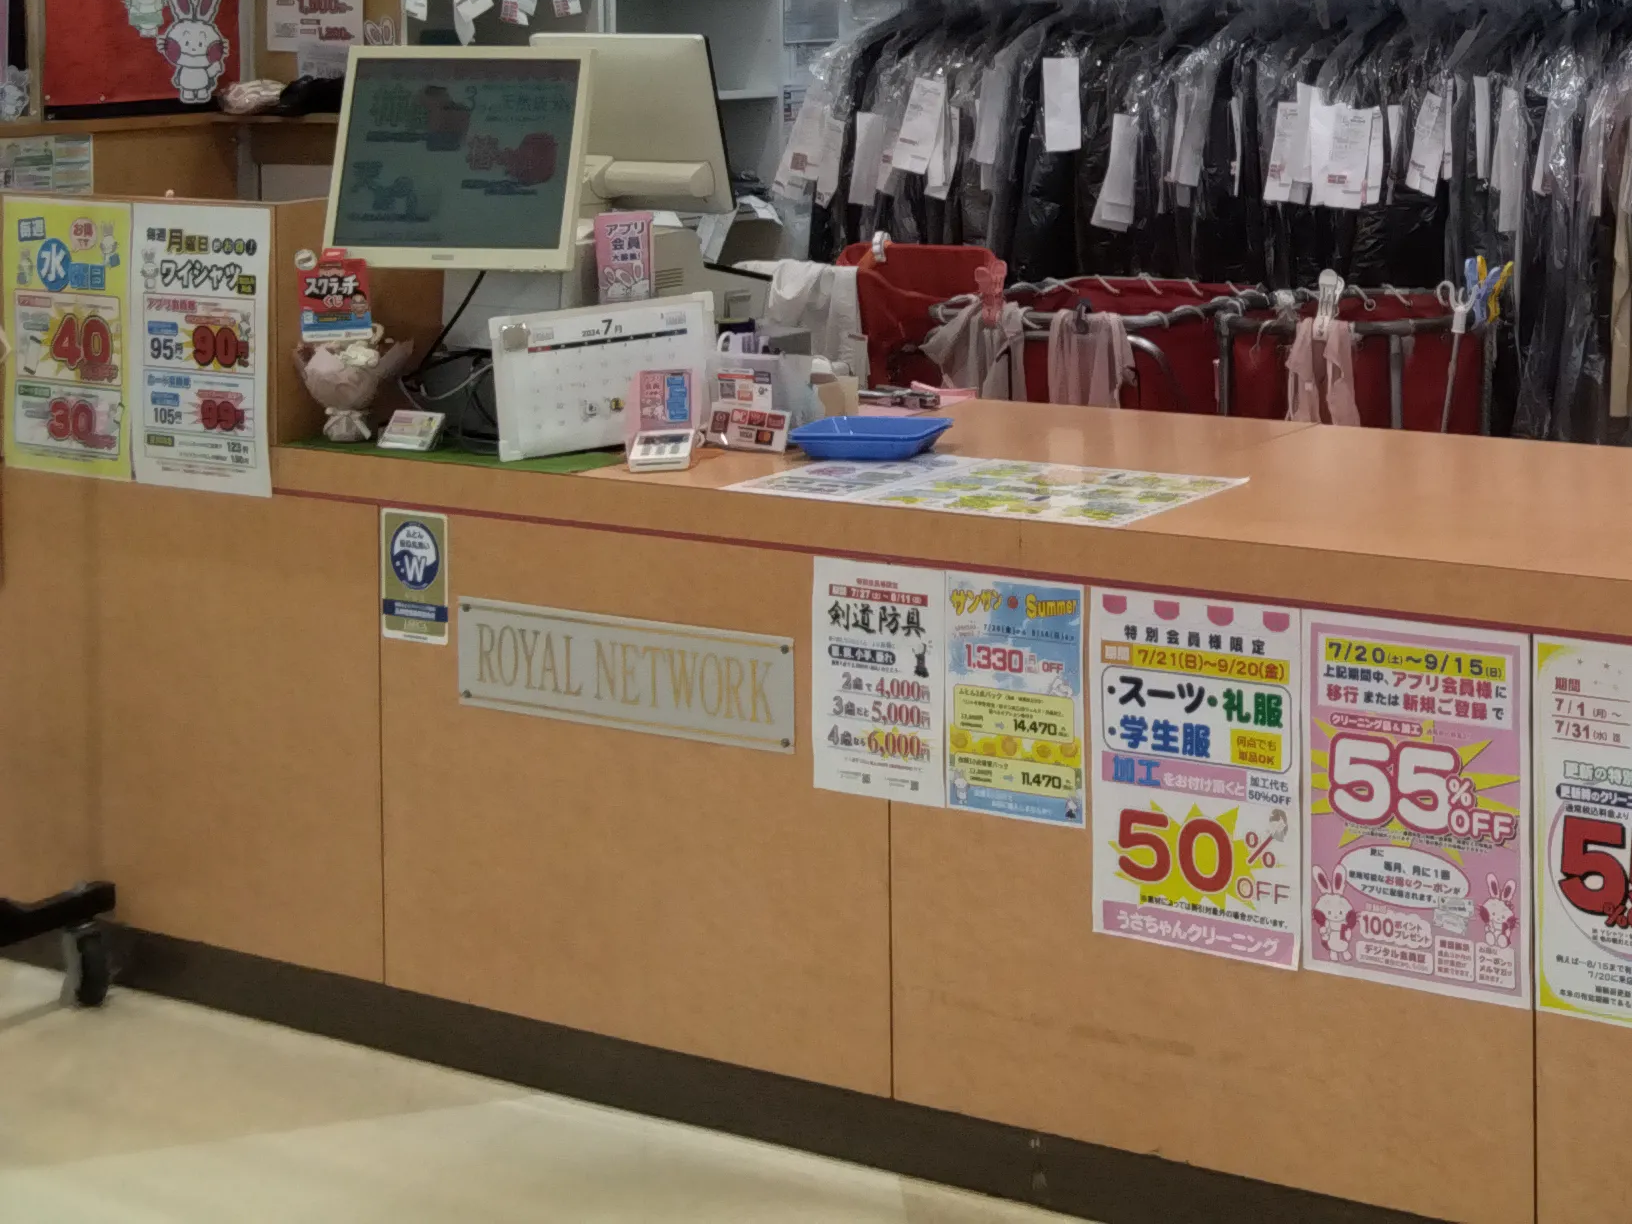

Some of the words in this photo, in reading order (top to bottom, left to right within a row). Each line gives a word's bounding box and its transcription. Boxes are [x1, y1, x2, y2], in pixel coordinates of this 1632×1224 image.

[606, 222, 645, 237] アプリ
[611, 236, 641, 251] 会員
[41, 243, 65, 283] 水
[160, 259, 242, 291] ワイシャツ
[304, 274, 359, 296] スクラッチ
[323, 295, 343, 308] くじ
[1025, 593, 1076, 619] Summer
[828, 599, 926, 637] 剣道防具
[1124, 625, 1266, 655] 特別会員様限定
[476, 622, 584, 697] ROYAL
[593, 637, 775, 725] NETWORK
[1042, 662, 1065, 674] OFF
[1555, 676, 1580, 692] 期間
[1013, 719, 1057, 736] 14,470
[1237, 735, 1277, 752] 何点でも
[1249, 776, 1289, 793] 加工代も
[1248, 790, 1291, 806] 50%OFF
[1449, 808, 1516, 842] OFF
[1236, 877, 1290, 904] OFF
[1117, 909, 1280, 956] うさちゃんクリーニング
[1362, 915, 1394, 937] 100
[1394, 931, 1430, 943] プレゼント
